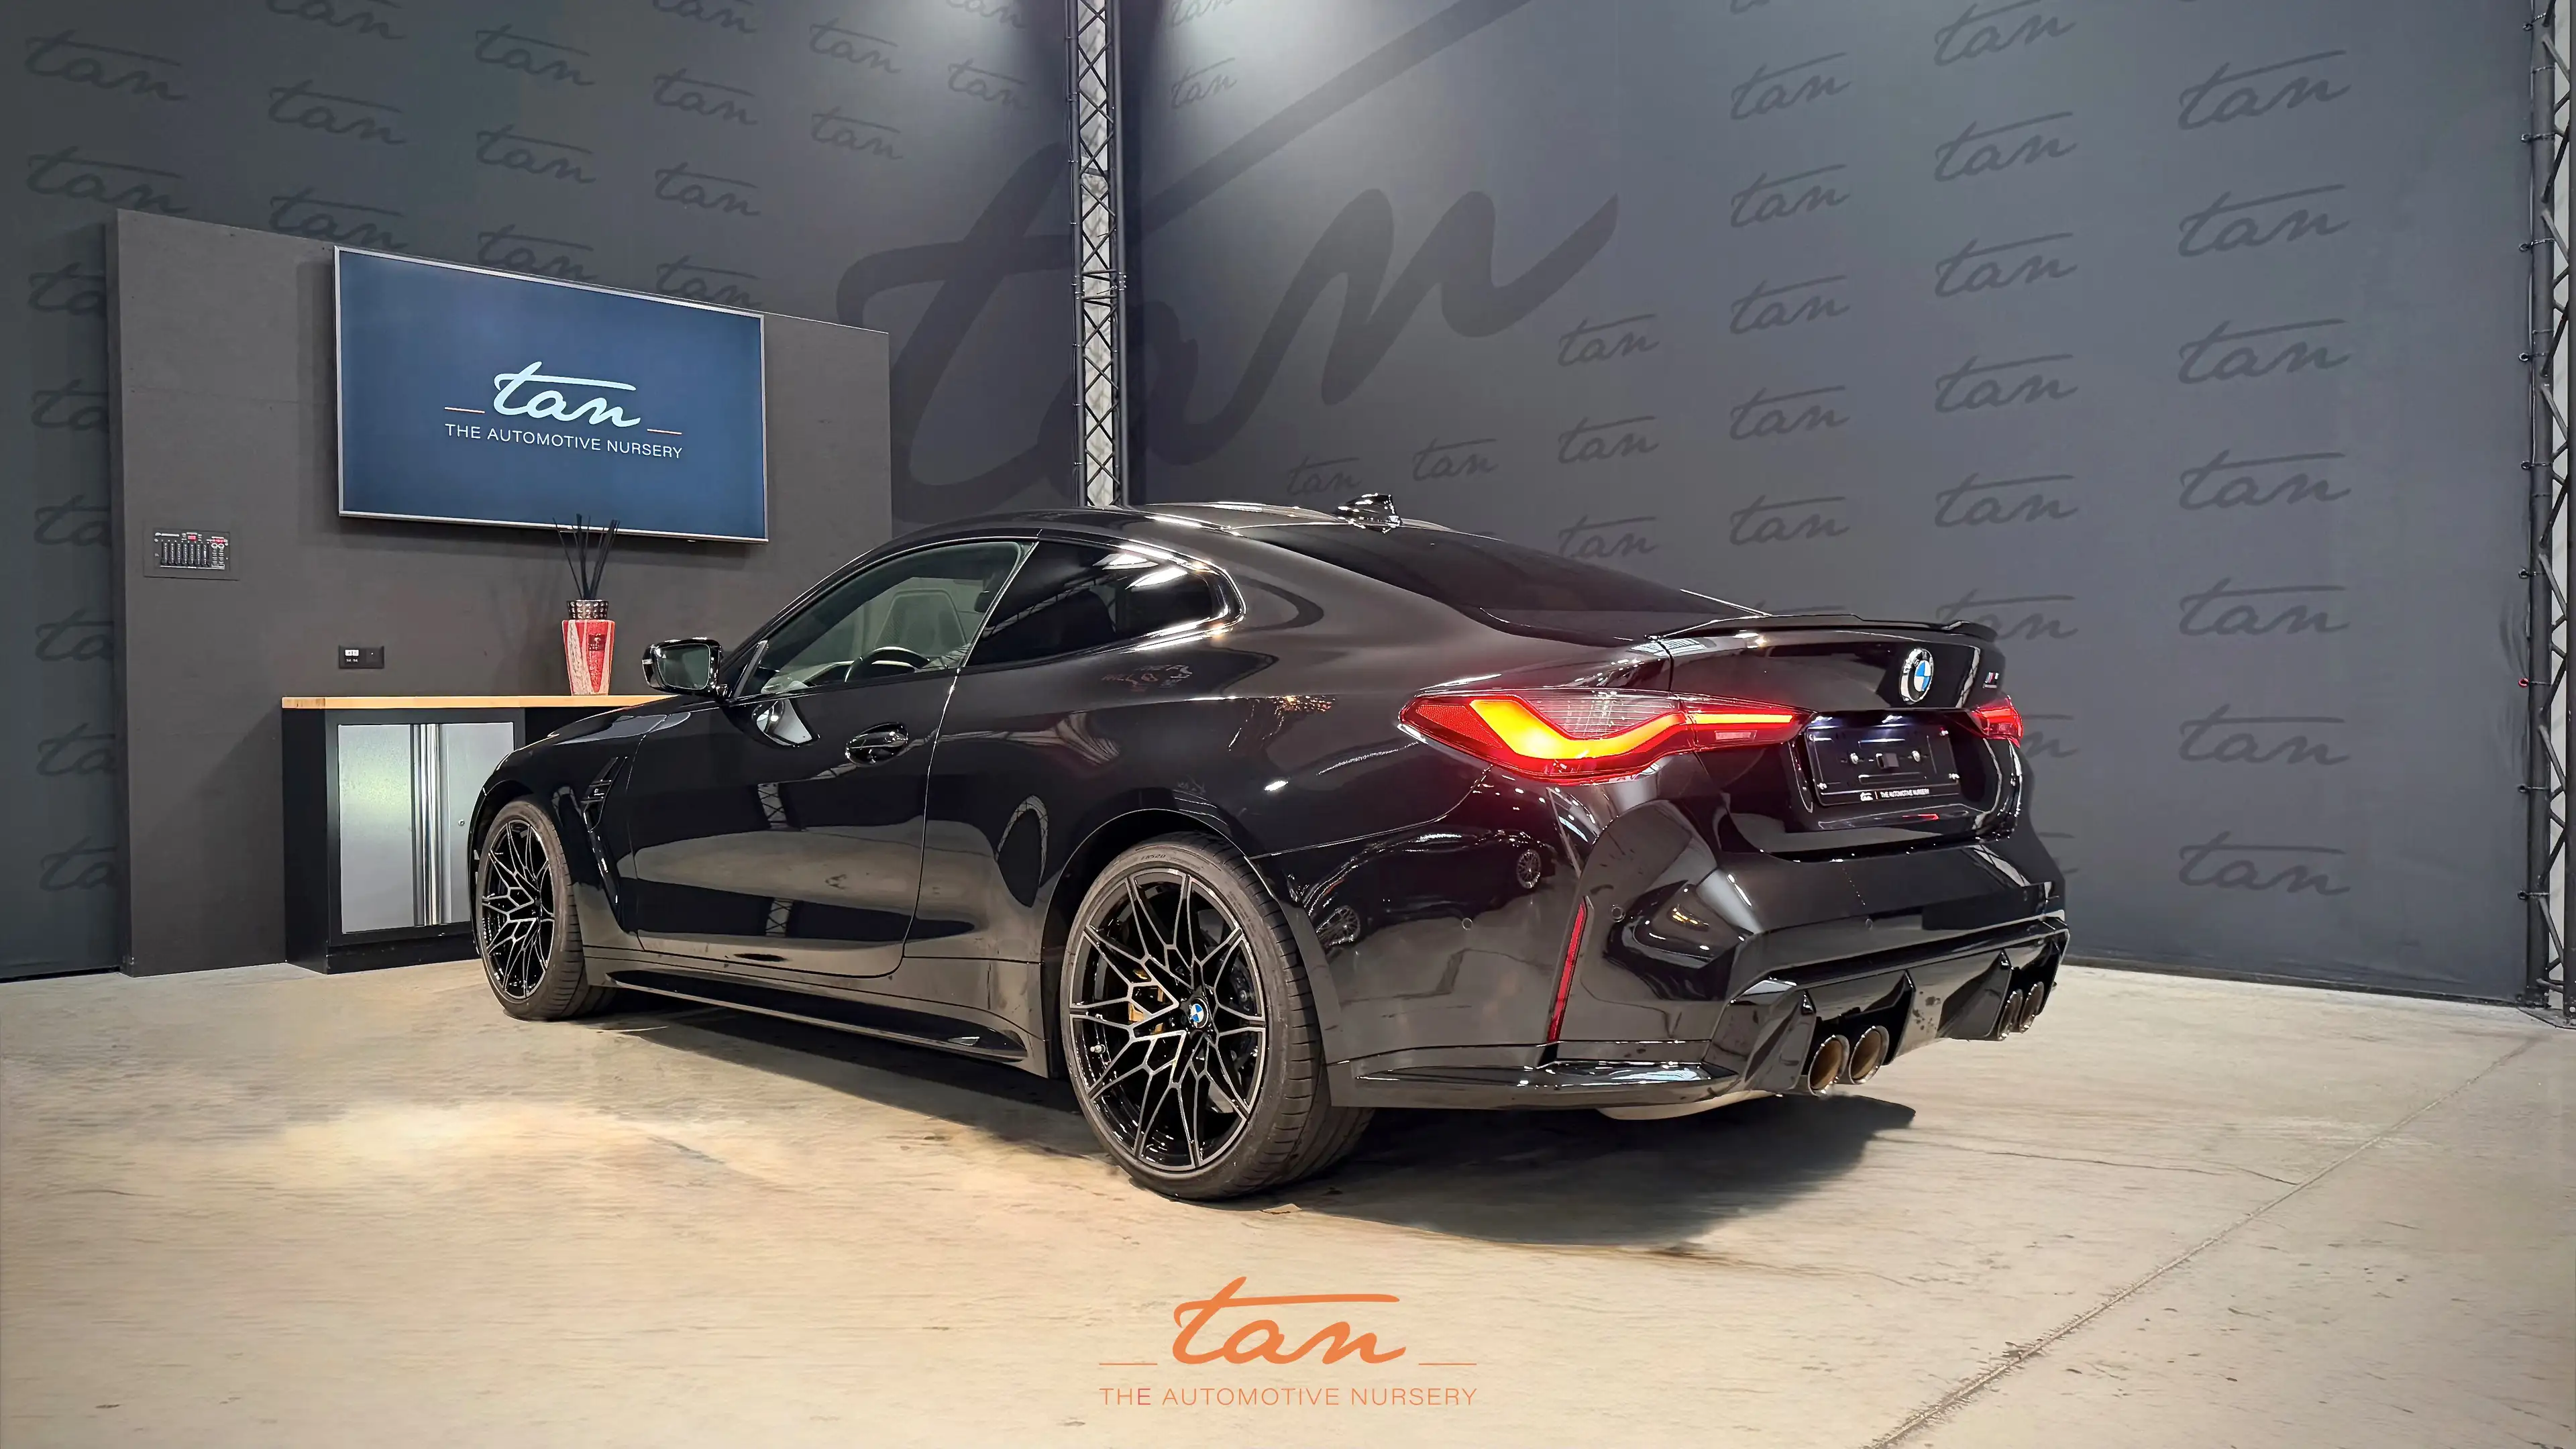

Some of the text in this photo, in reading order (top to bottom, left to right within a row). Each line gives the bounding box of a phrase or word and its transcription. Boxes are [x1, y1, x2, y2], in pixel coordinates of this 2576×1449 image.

[475, 23, 596, 86] tan
[810, 17, 902, 74] tan
[1934, 0, 2076, 66] tan
[24, 30, 188, 101] tan
[1171, 57, 1238, 110] tan
[1730, 51, 1852, 121] tan
[2178, 50, 2351, 130] tan
[268, 80, 407, 145] tan
[653, 68, 758, 125] tan
[476, 124, 596, 184] tan
[811, 106, 903, 160] tan
[1934, 111, 2078, 182] tan
[28, 146, 191, 214] tan
[655, 162, 761, 217] tan
[1730, 164, 1851, 228] tan
[270, 187, 409, 250] tan
[2178, 183, 2351, 257] tan
[477, 224, 598, 280] tan
[1934, 233, 2078, 298] tan
[29, 262, 106, 317] ta
[1729, 274, 1851, 335] tan
[1558, 313, 1660, 367] tan
[2178, 318, 2351, 384] tan
[31, 379, 109, 431] ta
[493, 361, 641, 428] tan
[1934, 354, 2079, 413] tan
[444, 423, 682, 459] THE AUTOMOTIVE NURSERY
[1558, 415, 1660, 464] tan
[1729, 385, 1850, 441] tan
[1286, 456, 1362, 496] tan
[1412, 437, 1498, 482] tan
[2178, 449, 2353, 511] tan
[33, 494, 111, 547] ta
[1729, 494, 1851, 546] tan
[1934, 473, 2079, 528] tan
[34, 608, 114, 662] ta
[2178, 578, 2351, 636] tan
[36, 722, 117, 777] ta
[2178, 703, 2352, 765] tan
[39, 835, 119, 892] ta
[2178, 831, 2352, 896] tan
